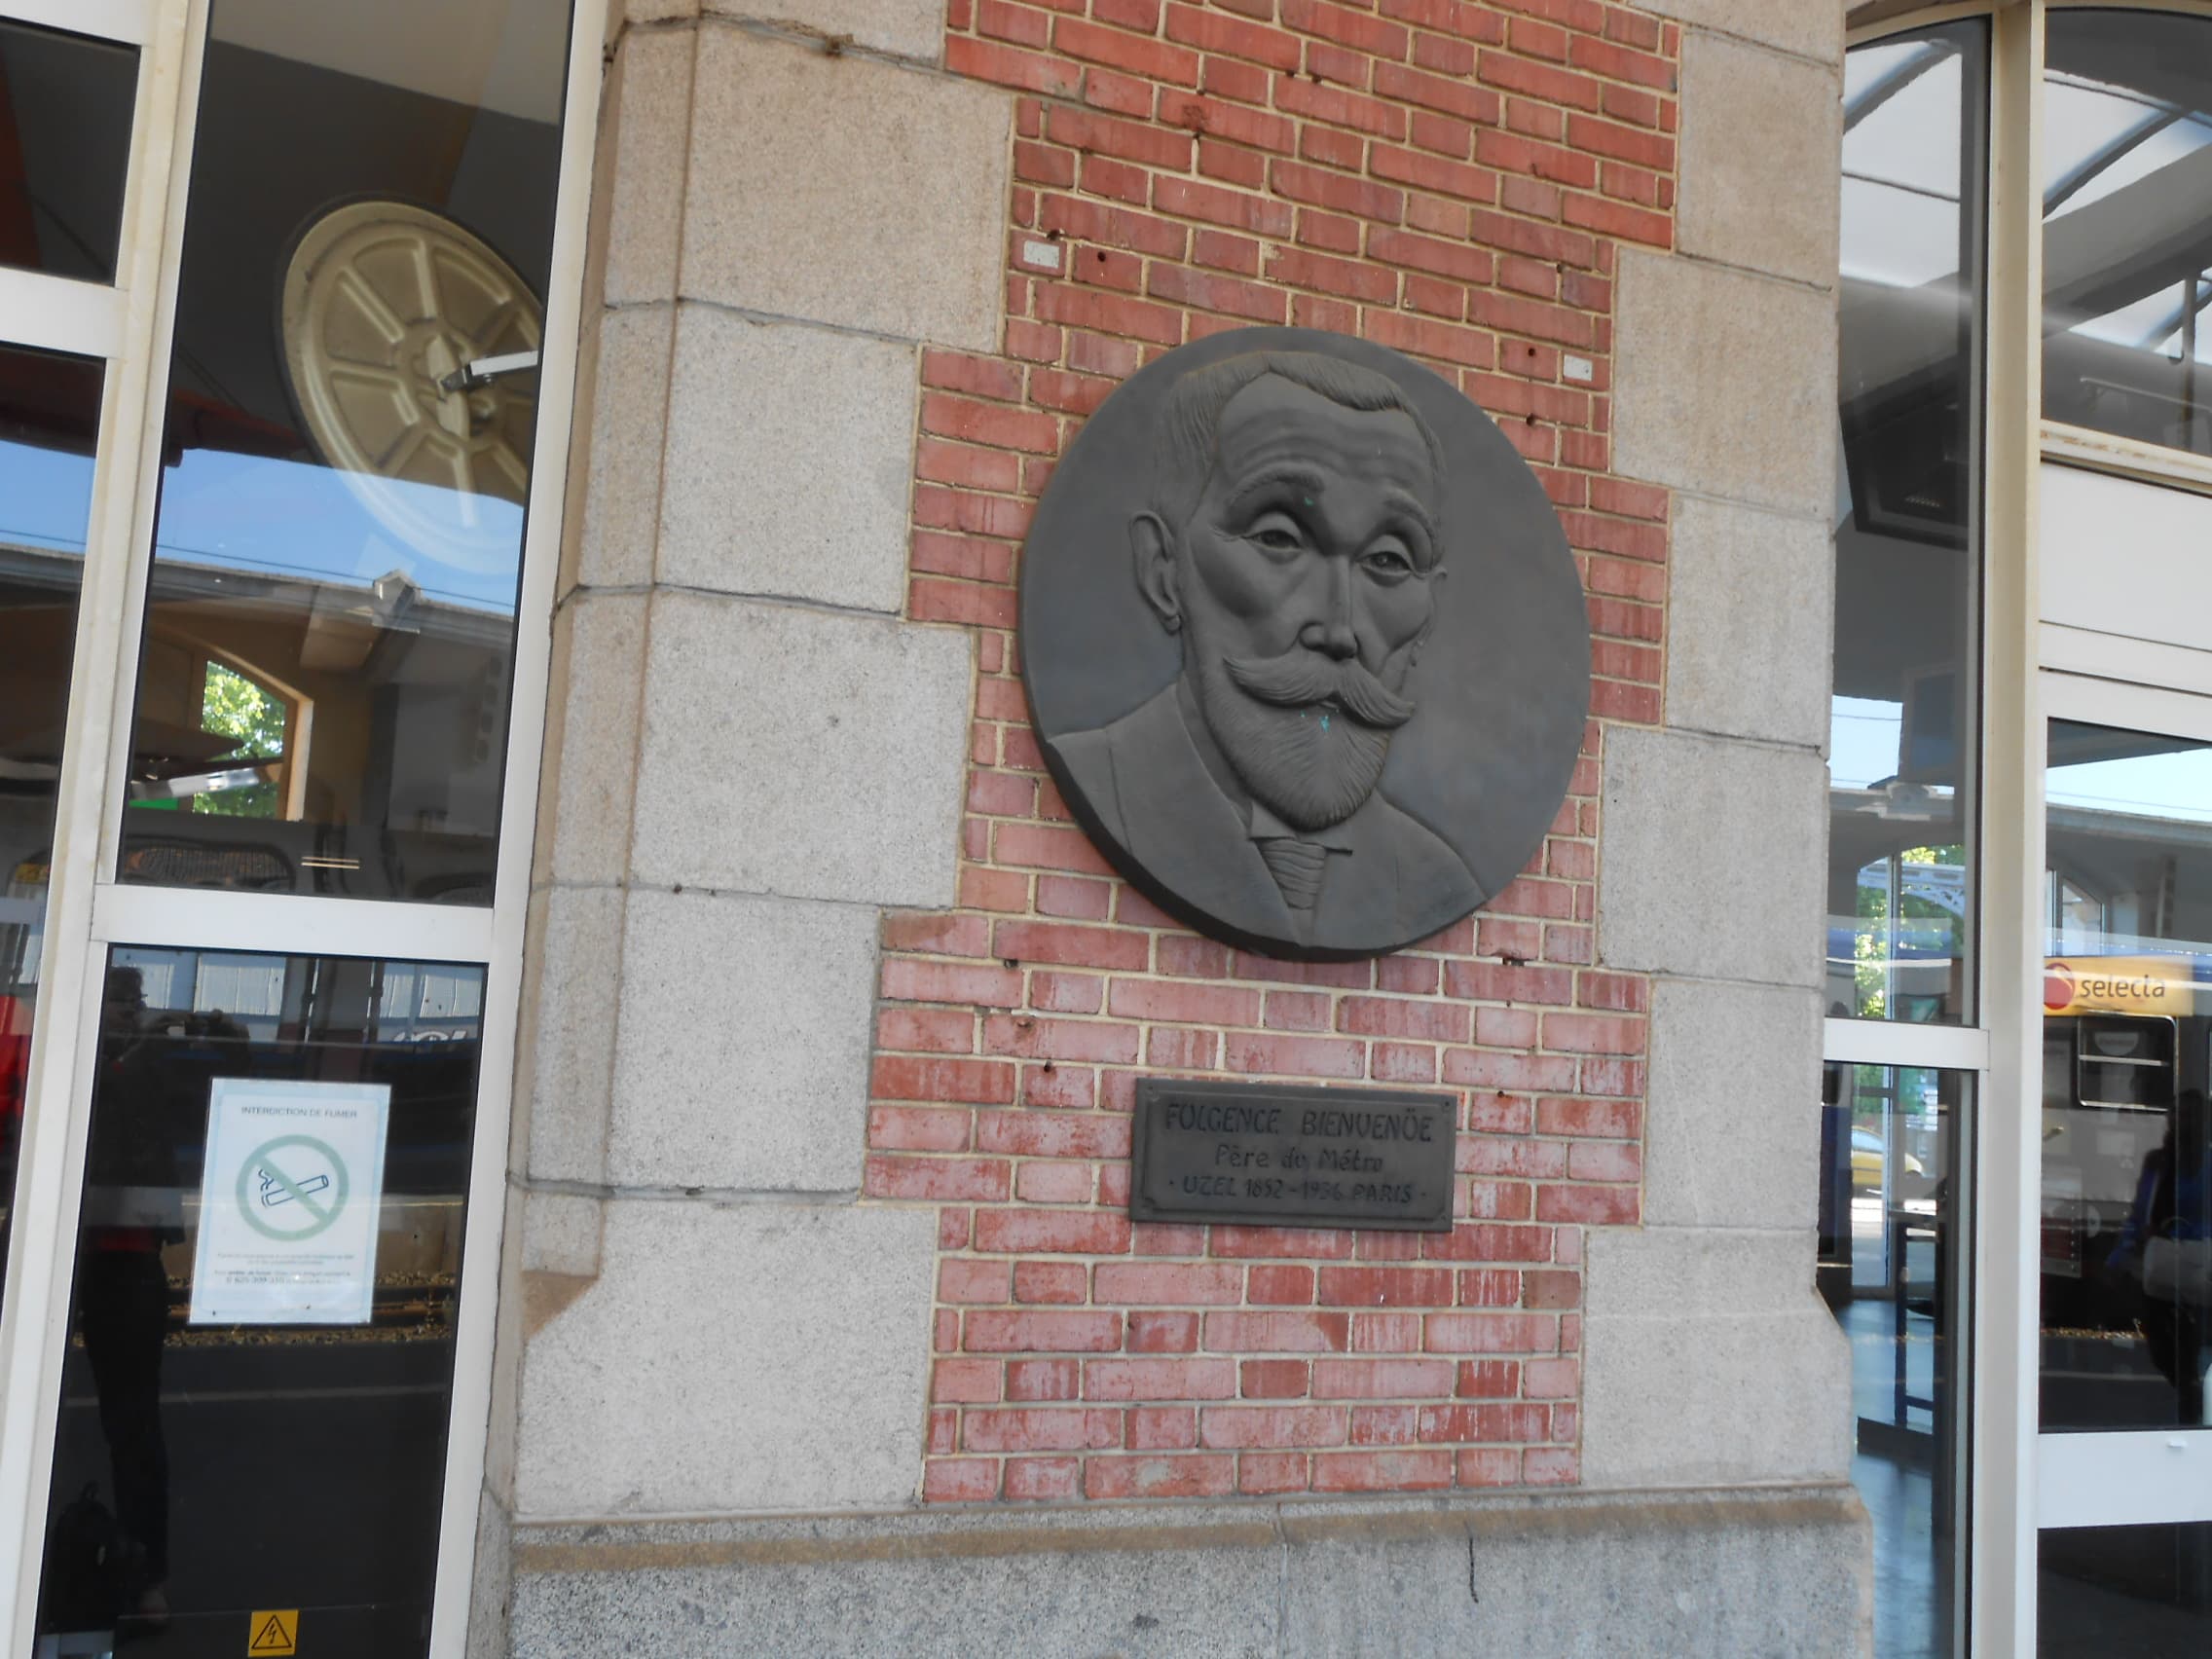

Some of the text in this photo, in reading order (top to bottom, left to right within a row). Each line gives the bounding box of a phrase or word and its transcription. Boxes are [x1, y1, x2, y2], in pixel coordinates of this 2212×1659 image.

[2080, 975, 2165, 998] selecta
[240, 1106, 357, 1119] INTERDICTION DE FUMER
[1214, 1144, 1270, 1168] Père
[1320, 1148, 1384, 1173] Métro
[1350, 1183, 1412, 1204] PARIS
